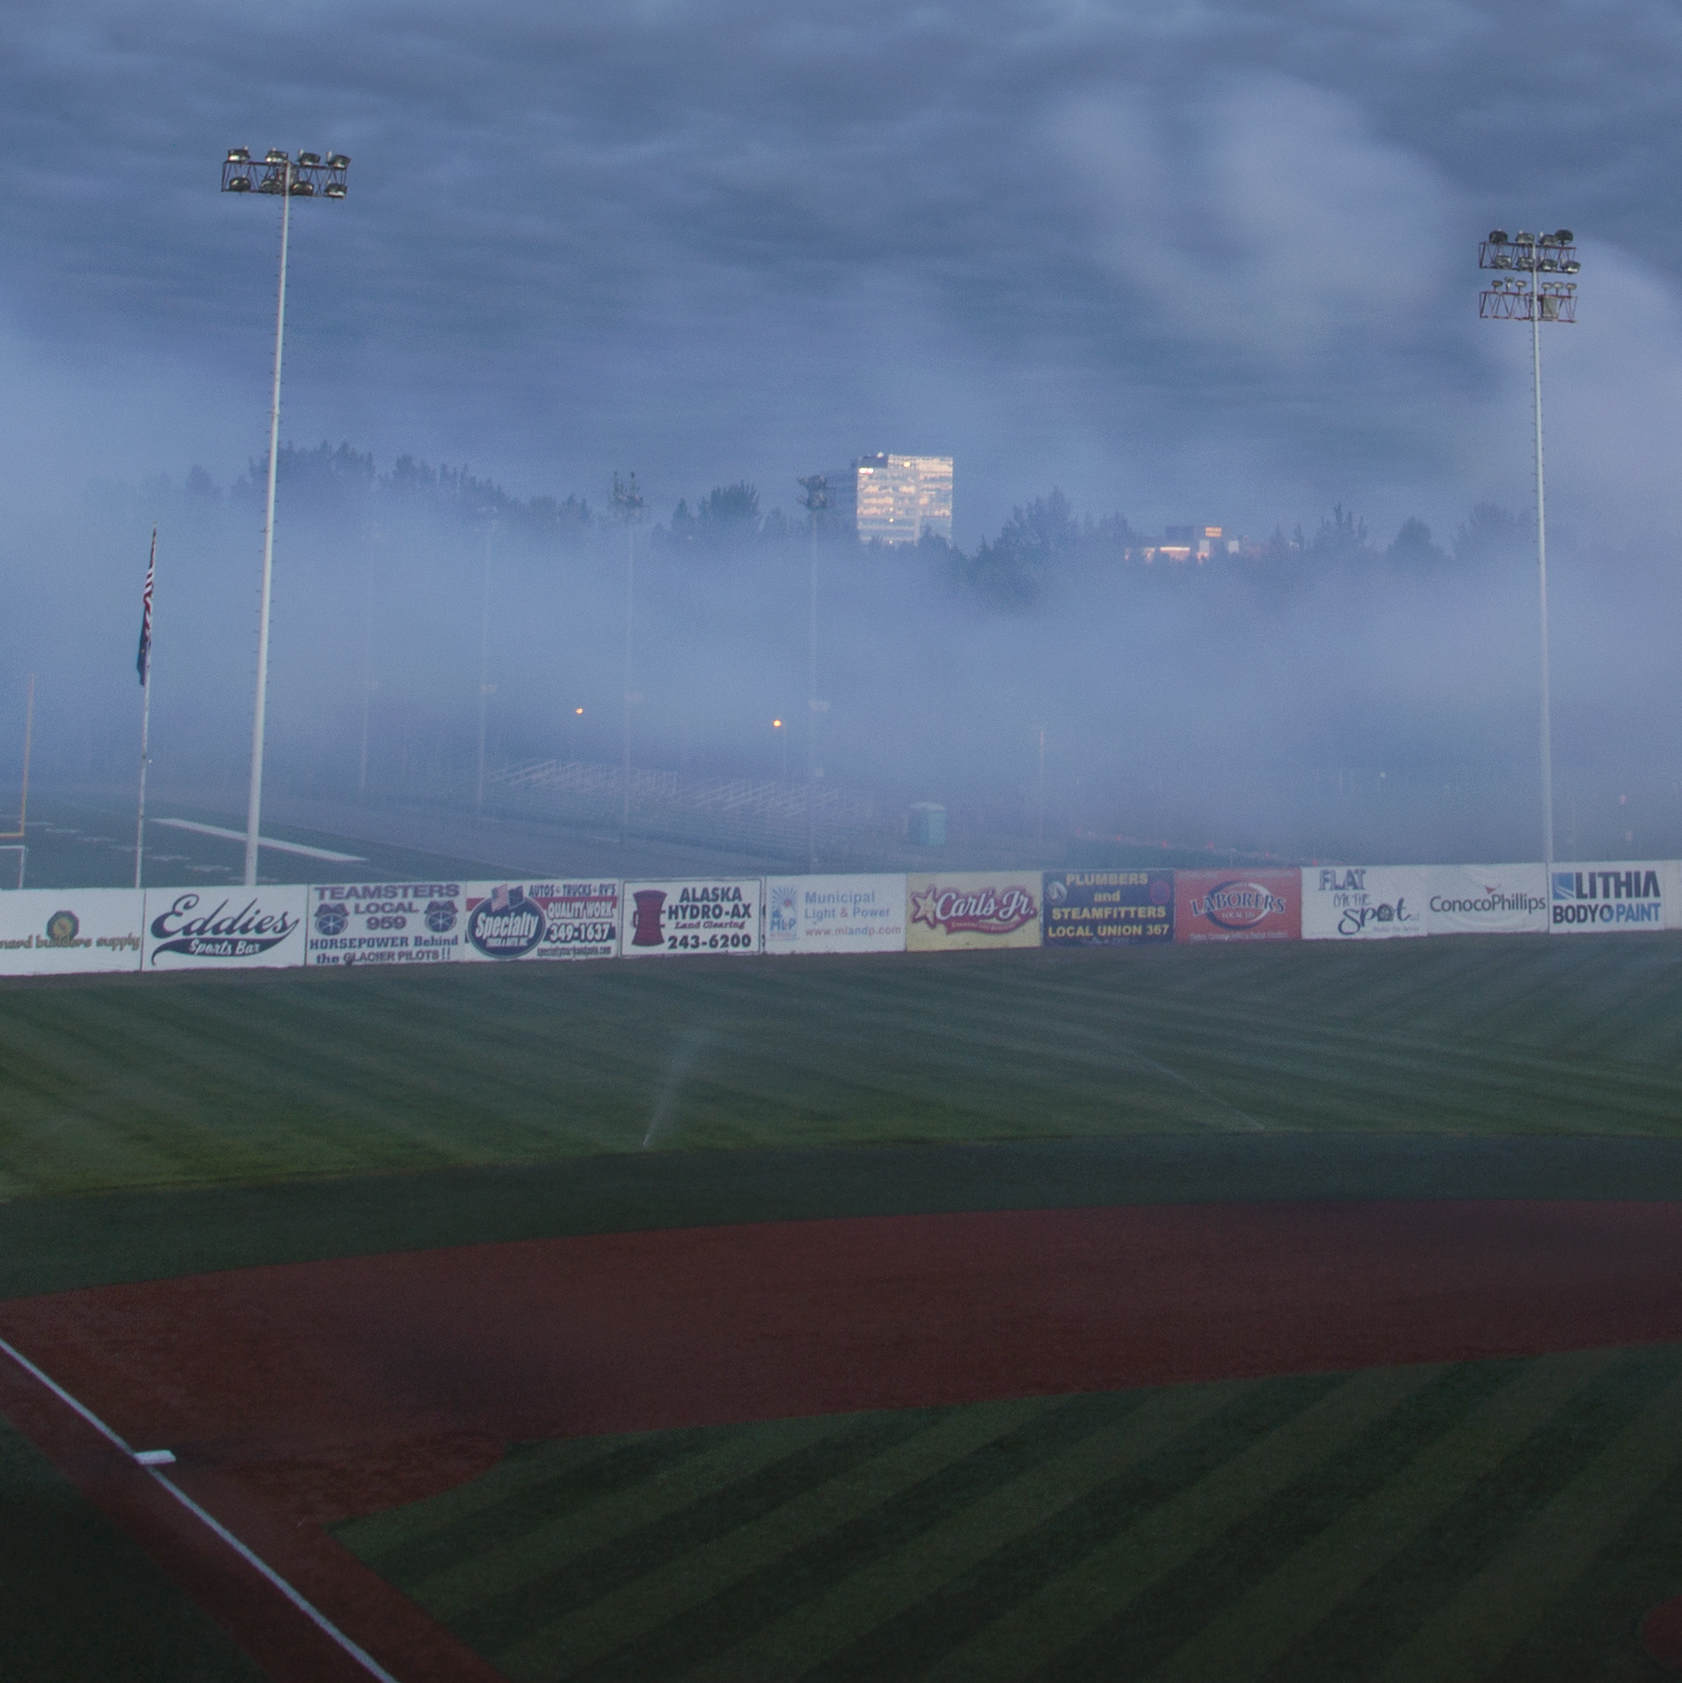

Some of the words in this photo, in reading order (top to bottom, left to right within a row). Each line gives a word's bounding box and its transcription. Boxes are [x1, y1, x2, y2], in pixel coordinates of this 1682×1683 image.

[1066, 872, 1148, 886] PLUMBERS
[1318, 869, 1366, 891] FLAT
[1575, 871, 1660, 899] LITHIA
[314, 883, 460, 900] TEAMSTERS
[528, 884, 555, 897] AUTOS
[562, 884, 591, 897] TRUCKS
[679, 886, 742, 903] ALASKA
[804, 889, 875, 906] Municipal
[1094, 889, 1121, 903] and
[354, 902, 419, 915] LOCAL
[547, 901, 585, 919] QUALITY
[586, 900, 613, 918] WORK
[668, 903, 751, 920] HYDRO-AX
[936, 890, 996, 921] Carl's
[999, 890, 1034, 919] Jr.
[1190, 892, 1286, 917] LABORERS
[1429, 892, 1546, 915] ConocoPhillips
[151, 893, 294, 939] Eddies
[804, 908, 836, 921] Light
[840, 908, 848, 918] &
[852, 907, 890, 919] Power
[1051, 906, 1166, 921] STEAMFITTERS
[1553, 904, 1598, 924] BODY
[1615, 902, 1661, 922] PAINT
[366, 916, 406, 932] 959
[475, 912, 539, 940] Specialty
[549, 923, 611, 942] 349-1637
[675, 921, 700, 930] Land
[702, 921, 746, 930] Clearing
[805, 925, 901, 938] www.mlandp.com
[1048, 924, 1093, 939] LOCAL
[1098, 924, 1142, 938] UNION
[1146, 923, 1170, 936] 367
[35, 933, 92, 949] builders
[96, 931, 140, 952] supply
[189, 938, 232, 956] Sports
[235, 940, 260, 955] Bar
[309, 937, 409, 950] HORSEPOWER
[413, 935, 458, 948] Behind
[668, 933, 751, 950] 243-6200
[316, 953, 340, 965] the
[343, 951, 395, 964] GLACIER
[397, 949, 439, 962] PILOTS
